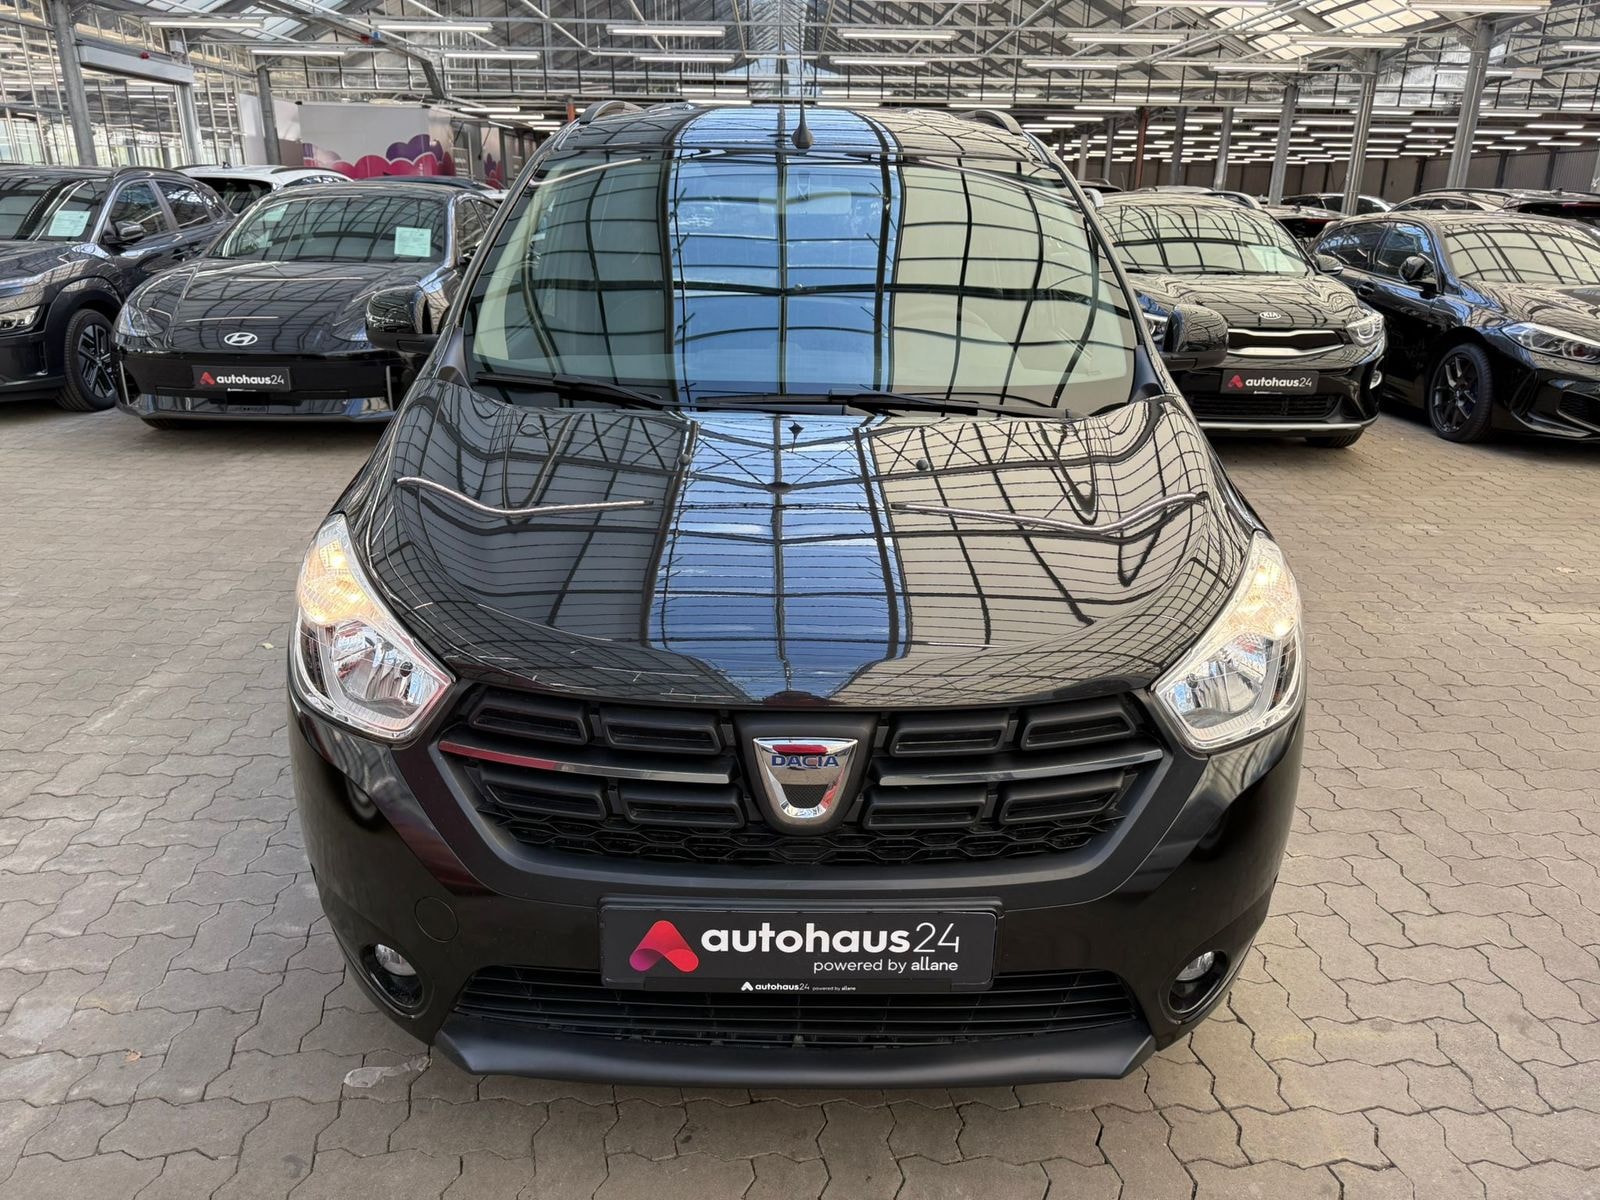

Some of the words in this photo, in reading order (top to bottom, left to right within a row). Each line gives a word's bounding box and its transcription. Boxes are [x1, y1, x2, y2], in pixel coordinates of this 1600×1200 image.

[1263, 311, 1279, 319] KIA
[216, 374, 285, 385] autohaus24
[1245, 377, 1312, 387] autohaus24
[771, 755, 839, 767] DACIA
[701, 921, 960, 954] autohaus24
[813, 958, 883, 974] powered
[887, 958, 906, 974] by
[911, 957, 959, 972] allane
[755, 983, 810, 991] autohaus24
